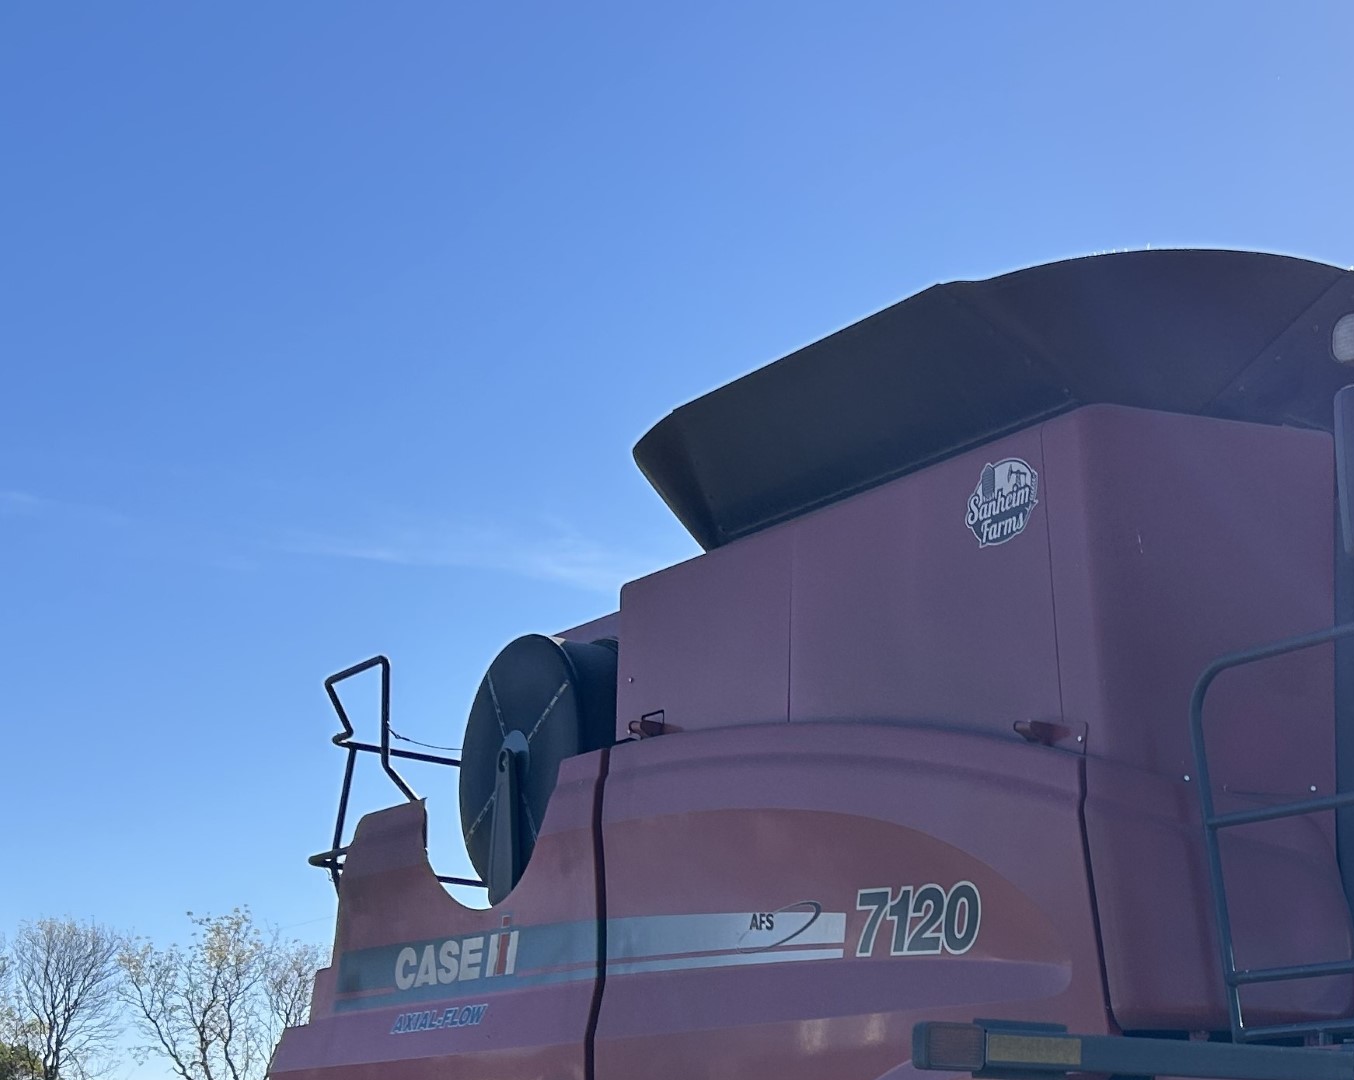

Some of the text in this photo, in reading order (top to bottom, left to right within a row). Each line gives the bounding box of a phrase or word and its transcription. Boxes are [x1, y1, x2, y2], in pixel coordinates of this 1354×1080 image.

[968, 486, 1030, 525] Sanheim
[981, 511, 1025, 544] Farms
[749, 912, 775, 931] AFS
[855, 880, 983, 957] 7120
[394, 936, 485, 991] CASE
[389, 1003, 489, 1035] AXIAL-FLOW
